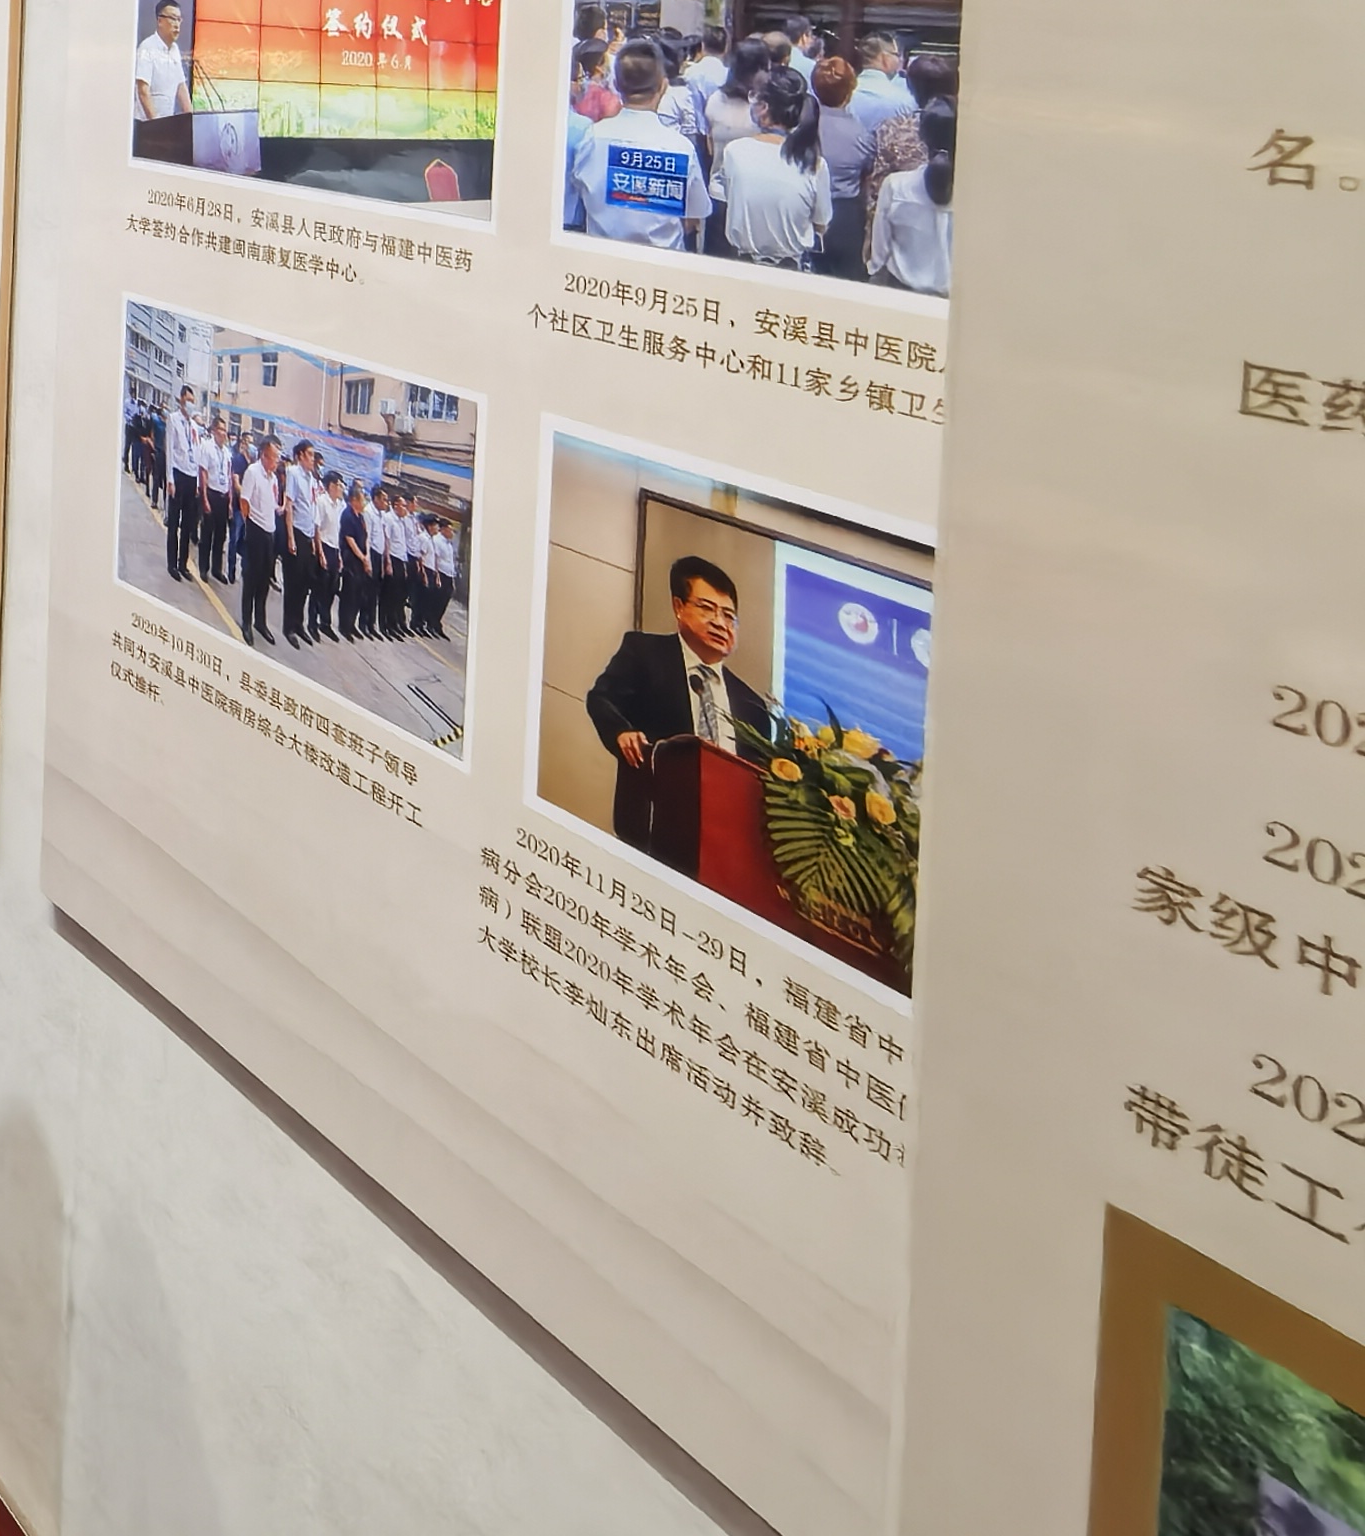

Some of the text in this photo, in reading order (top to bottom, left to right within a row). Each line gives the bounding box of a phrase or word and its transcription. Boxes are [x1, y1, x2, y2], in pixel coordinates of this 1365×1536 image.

[322, 8, 430, 47] 签约仪式
[612, 172, 684, 201] 安溪新闻
[620, 151, 676, 172] 9月25日
[564, 272, 945, 374] 2020年9月25日，安溪县中医院
[1131, 864, 1363, 996] 家级中
[1122, 1082, 1365, 1244] 带徒工
